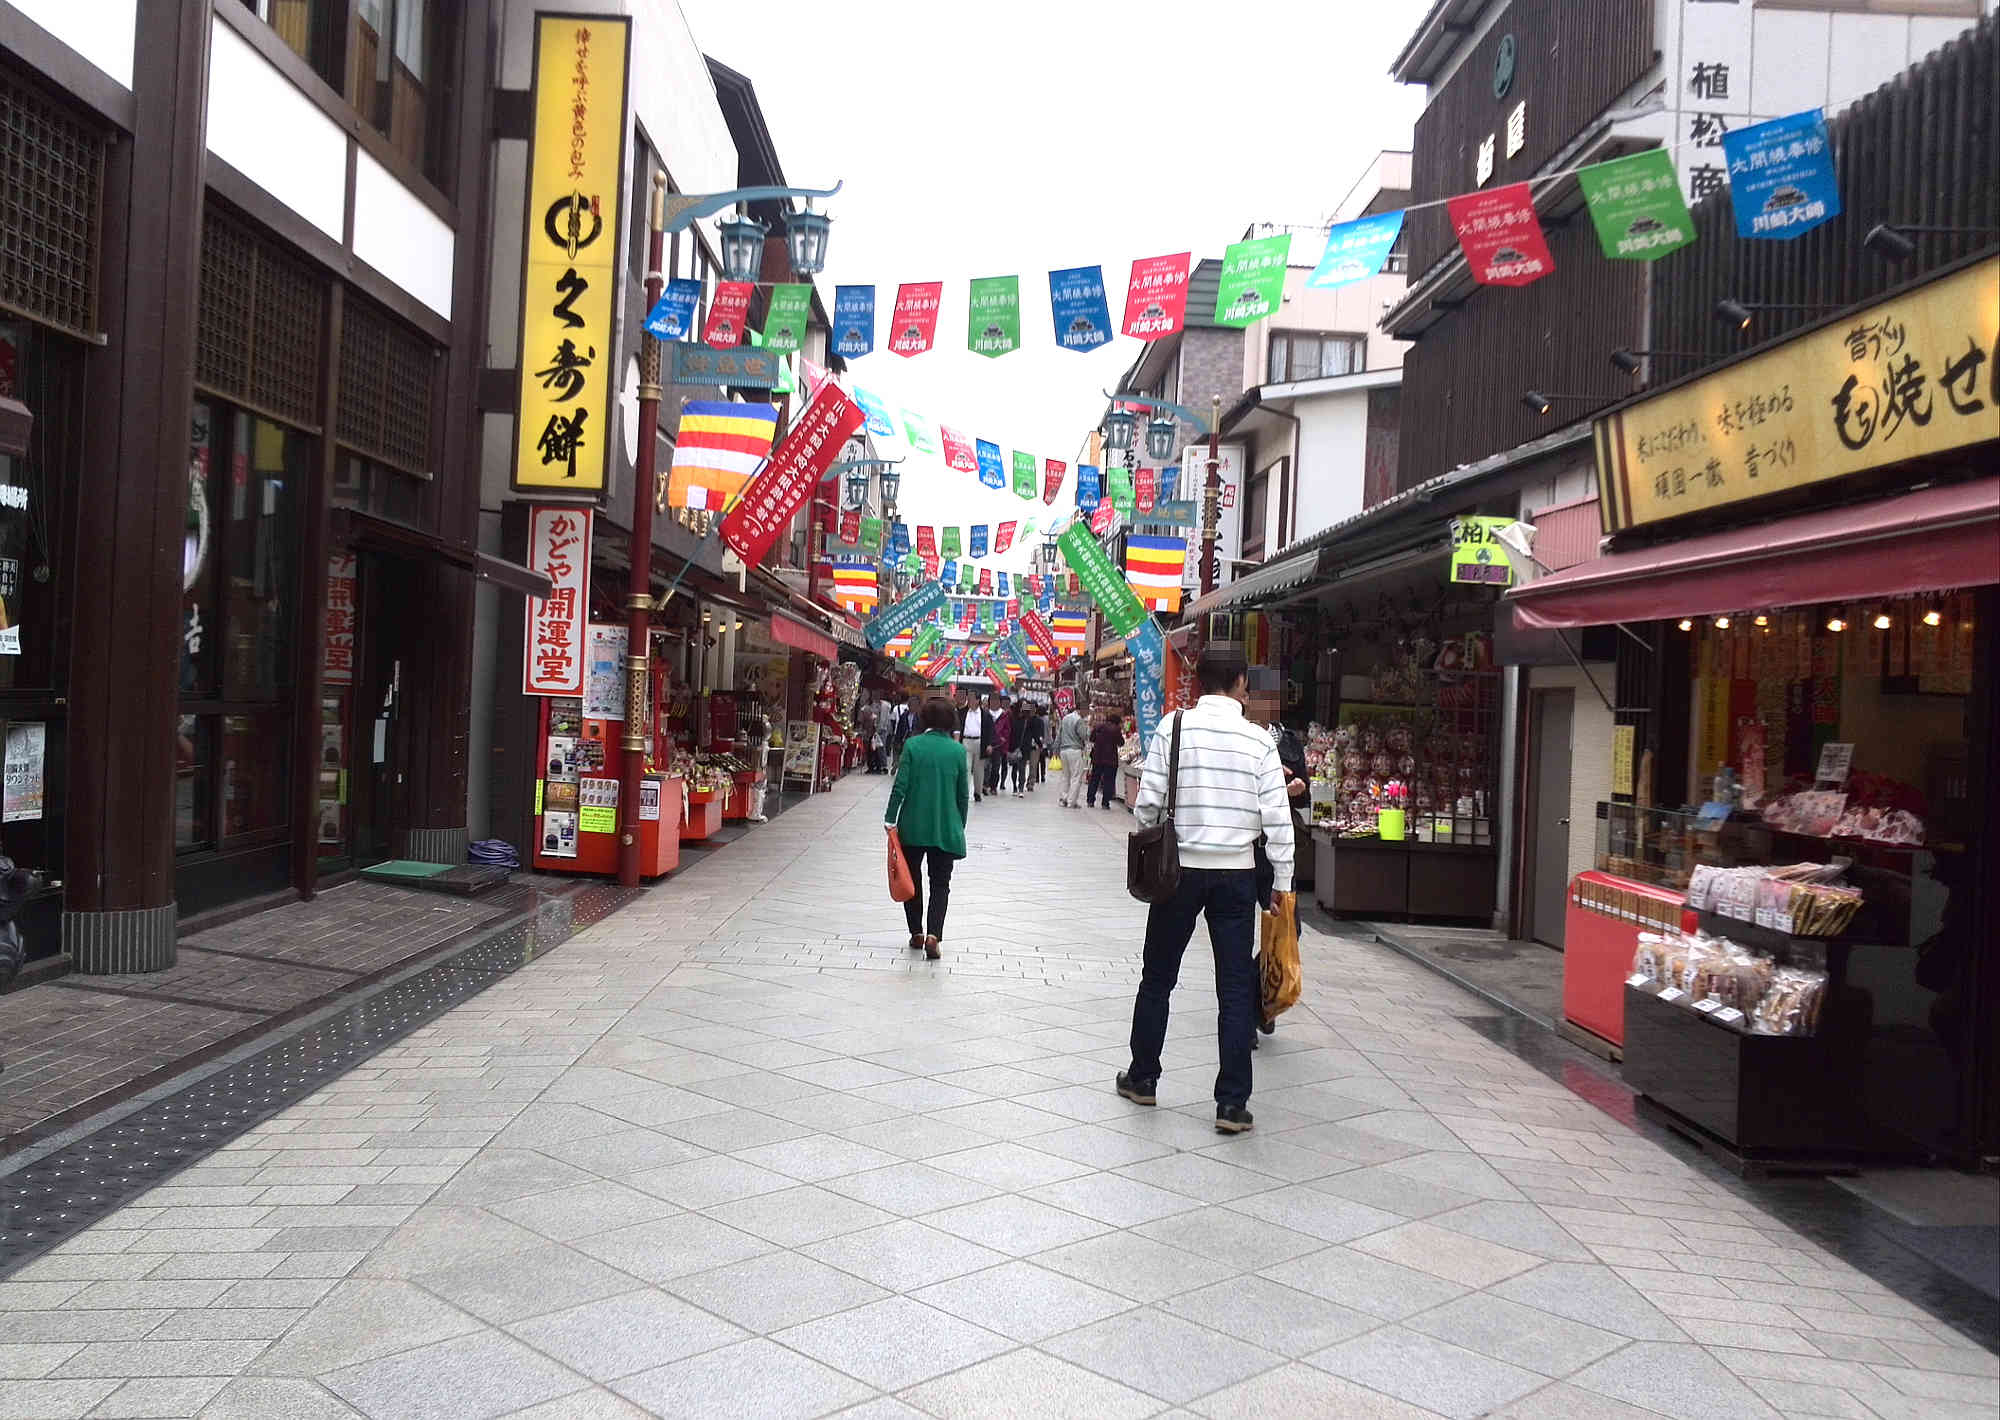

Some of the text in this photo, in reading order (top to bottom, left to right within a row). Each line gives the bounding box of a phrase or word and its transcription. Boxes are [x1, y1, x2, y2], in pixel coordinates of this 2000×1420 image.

[1753, 201, 1825, 232] 川崎大師
[1129, 319, 1173, 334] 川崎大師
[1831, 336, 2000, 450] もち焼せ
[536, 515, 580, 684] かどや開運堂
